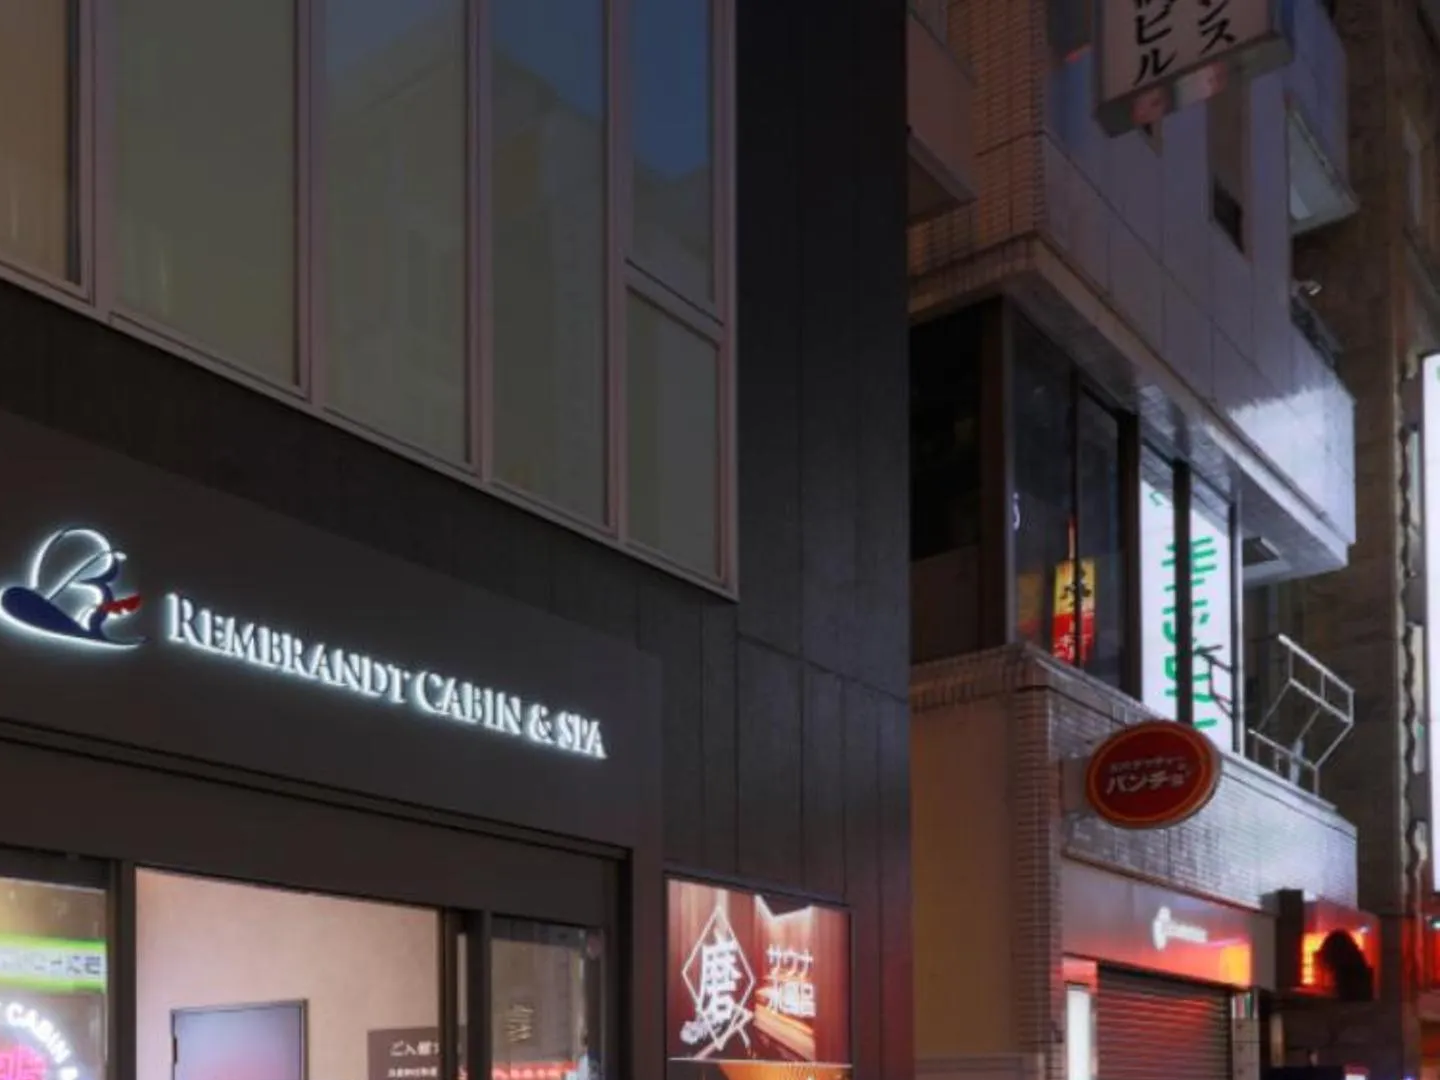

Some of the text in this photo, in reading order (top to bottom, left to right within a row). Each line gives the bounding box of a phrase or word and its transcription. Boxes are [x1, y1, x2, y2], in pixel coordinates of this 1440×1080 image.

[166, 592, 608, 759] REMBRANDT CABIN & SPA
